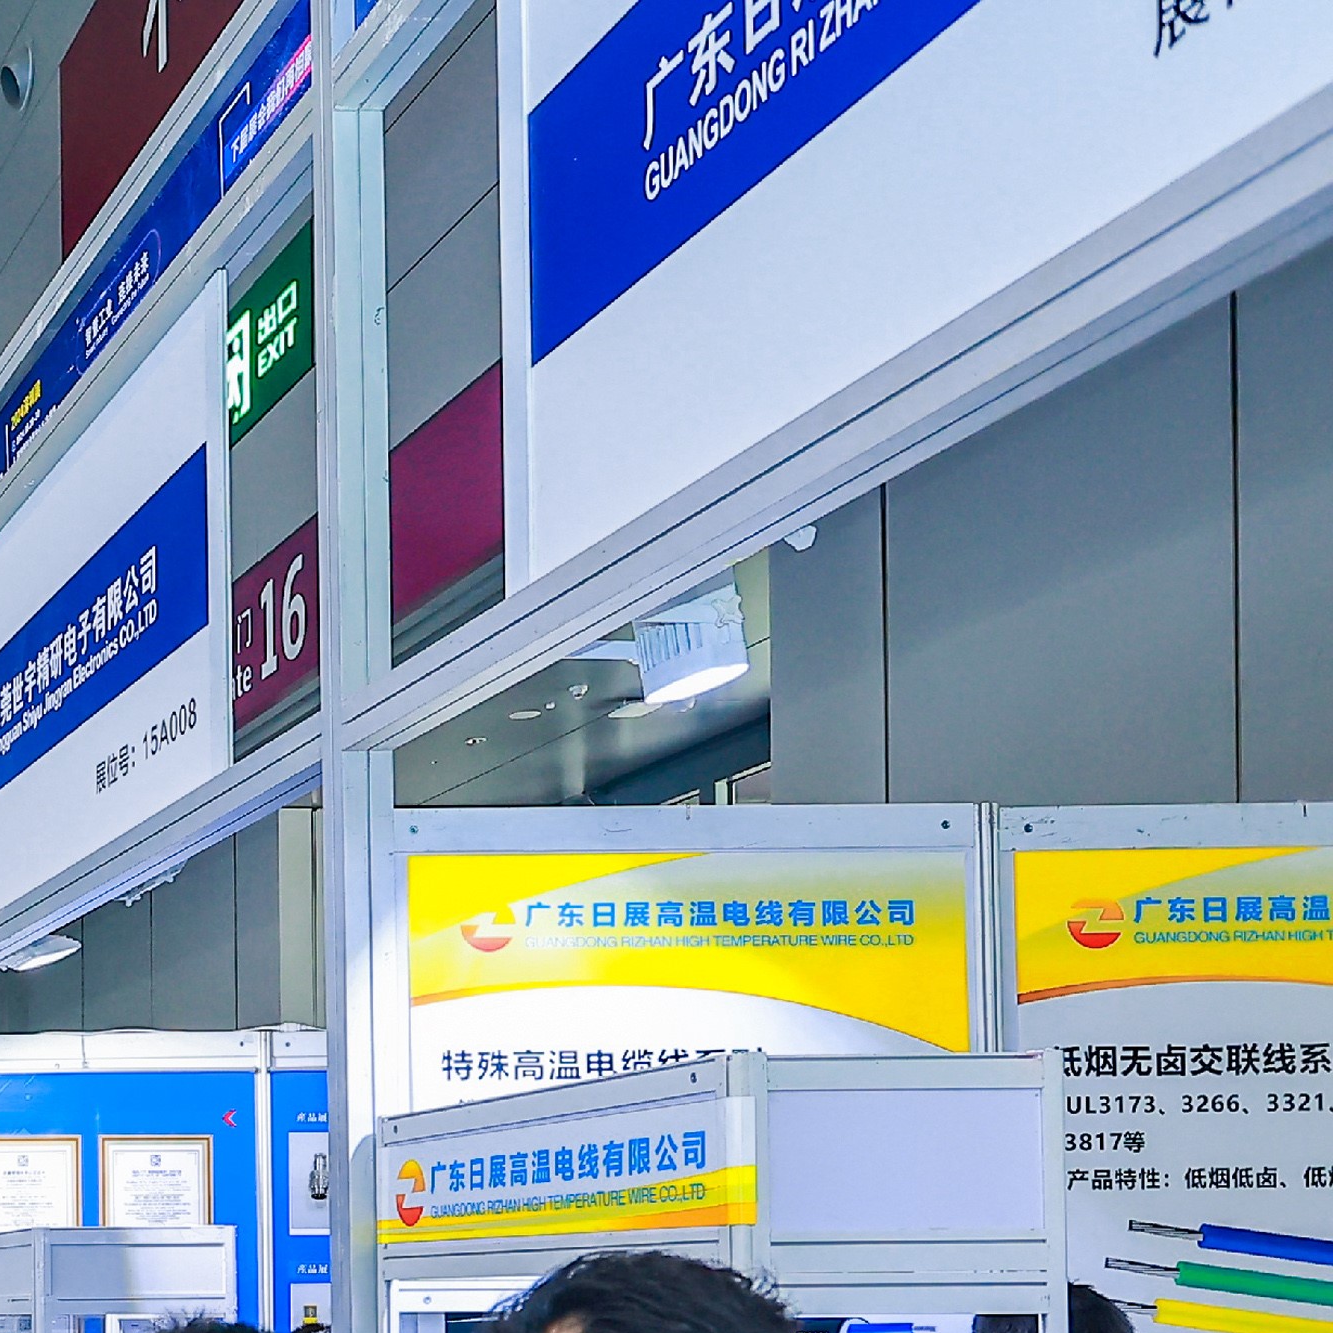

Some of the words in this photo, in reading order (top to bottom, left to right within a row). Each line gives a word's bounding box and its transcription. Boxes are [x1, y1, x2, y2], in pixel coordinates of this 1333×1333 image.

[644, 47, 786, 202] GUANGDONG
[257, 280, 297, 345] 出口
[257, 316, 297, 378] EXIT
[258, 554, 305, 682] 16
[72, 637, 119, 688] Electronics
[143, 697, 197, 760] 15A008
[525, 899, 916, 929] 广东日展高温电线有限公司
[1133, 894, 1330, 923] 广东日展高温
[525, 936, 618, 948] GUANGDONG
[621, 936, 673, 947] RIZHAN
[676, 935, 710, 947] HIGH
[713, 935, 817, 947] TEMPERATURE
[820, 934, 857, 946] WIRE
[1134, 931, 1230, 944] GUANGDONG
[1233, 931, 1286, 943] RIZHAN
[1288, 930, 1324, 942] HIGH
[430, 1130, 707, 1194] 广东日展高温电线有限公司
[1064, 1130, 1145, 1153] 3817等
[431, 1202, 486, 1219] GUANGDONG
[486, 1199, 520, 1213] RIZHAN
[520, 1197, 546, 1212] HIGH
[546, 1190, 625, 1211] TEMPERATURE
[625, 1187, 657, 1205] WIRE
